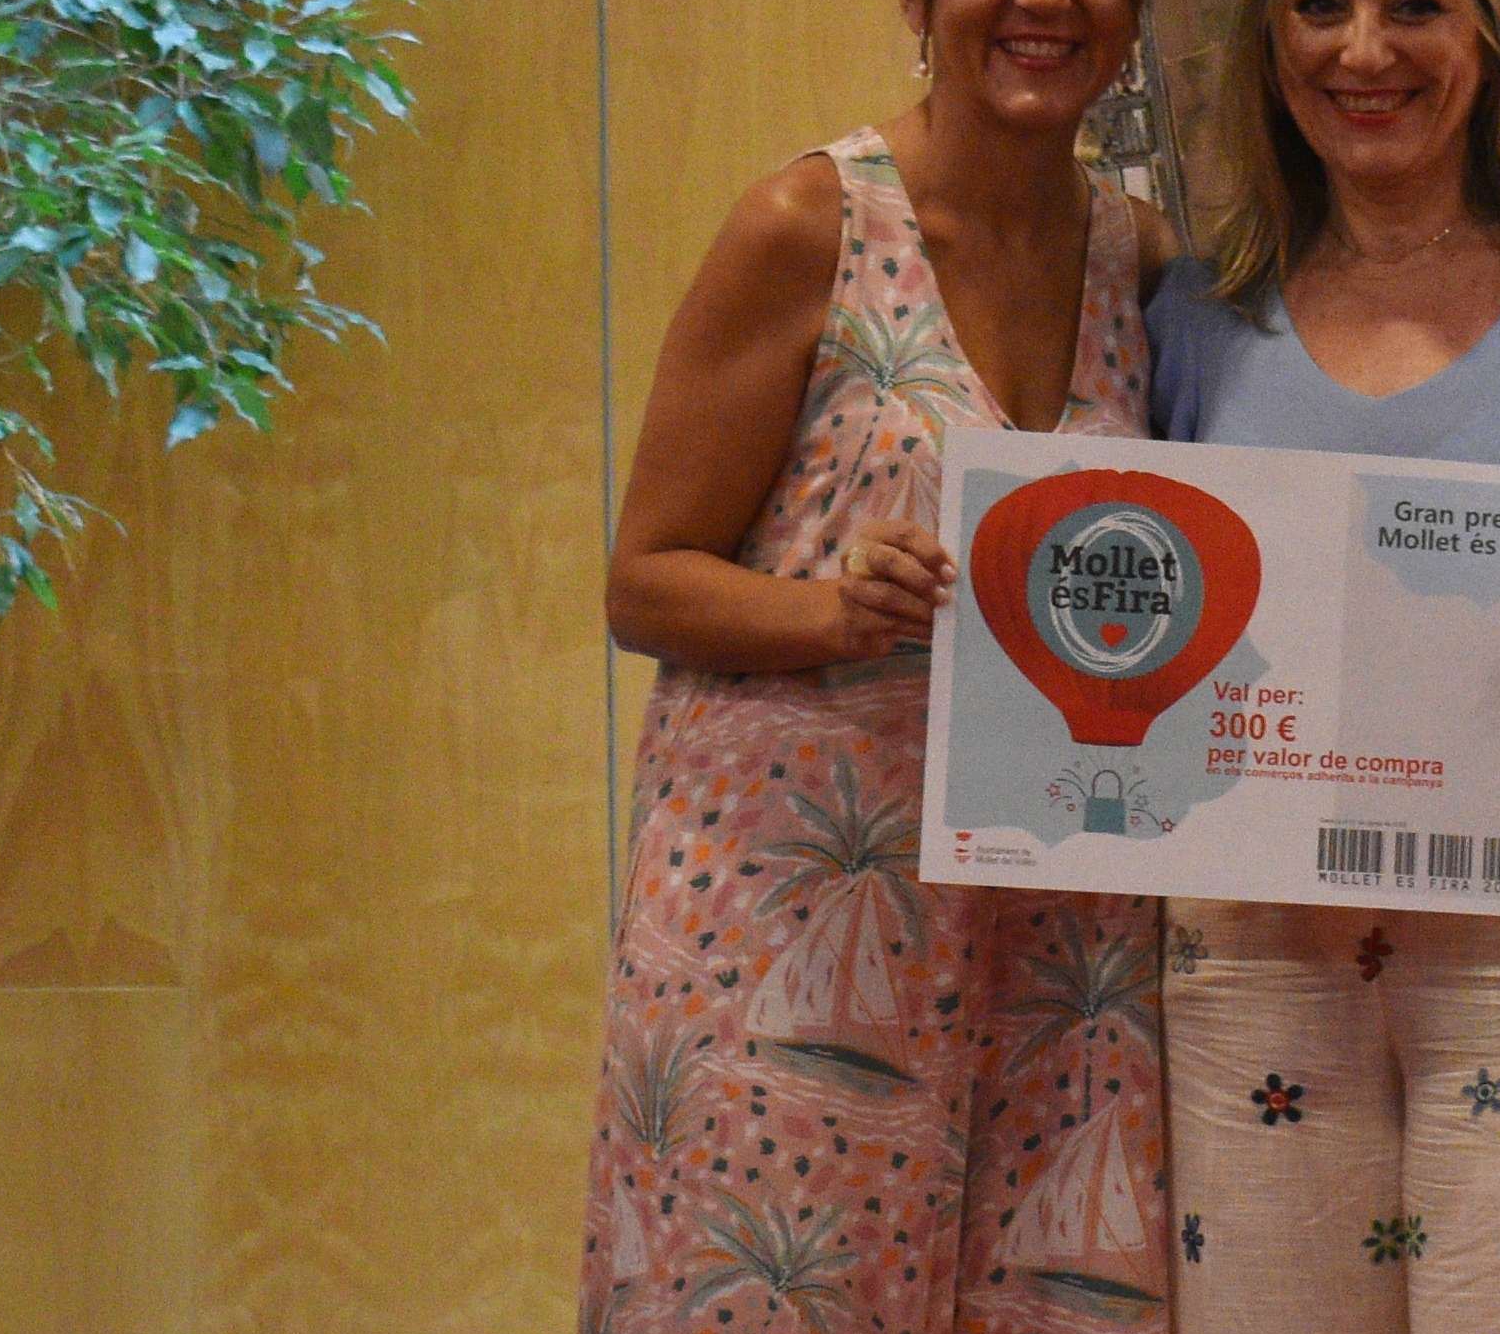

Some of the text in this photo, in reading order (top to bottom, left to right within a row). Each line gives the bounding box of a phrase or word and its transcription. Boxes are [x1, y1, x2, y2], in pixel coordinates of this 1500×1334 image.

[1394, 500, 1454, 525] Gran
[1378, 526, 1460, 553] Mollet
[1470, 532, 1497, 555] és
[1050, 543, 1177, 582] Mollet
[1213, 680, 1304, 708] Val per:
[1209, 710, 1297, 742] 300 €
[1206, 746, 1444, 778] per valor de compra
[1317, 871, 1382, 886] MOLLET
[1395, 875, 1416, 889] ES
[1429, 878, 1470, 892] FIRA
